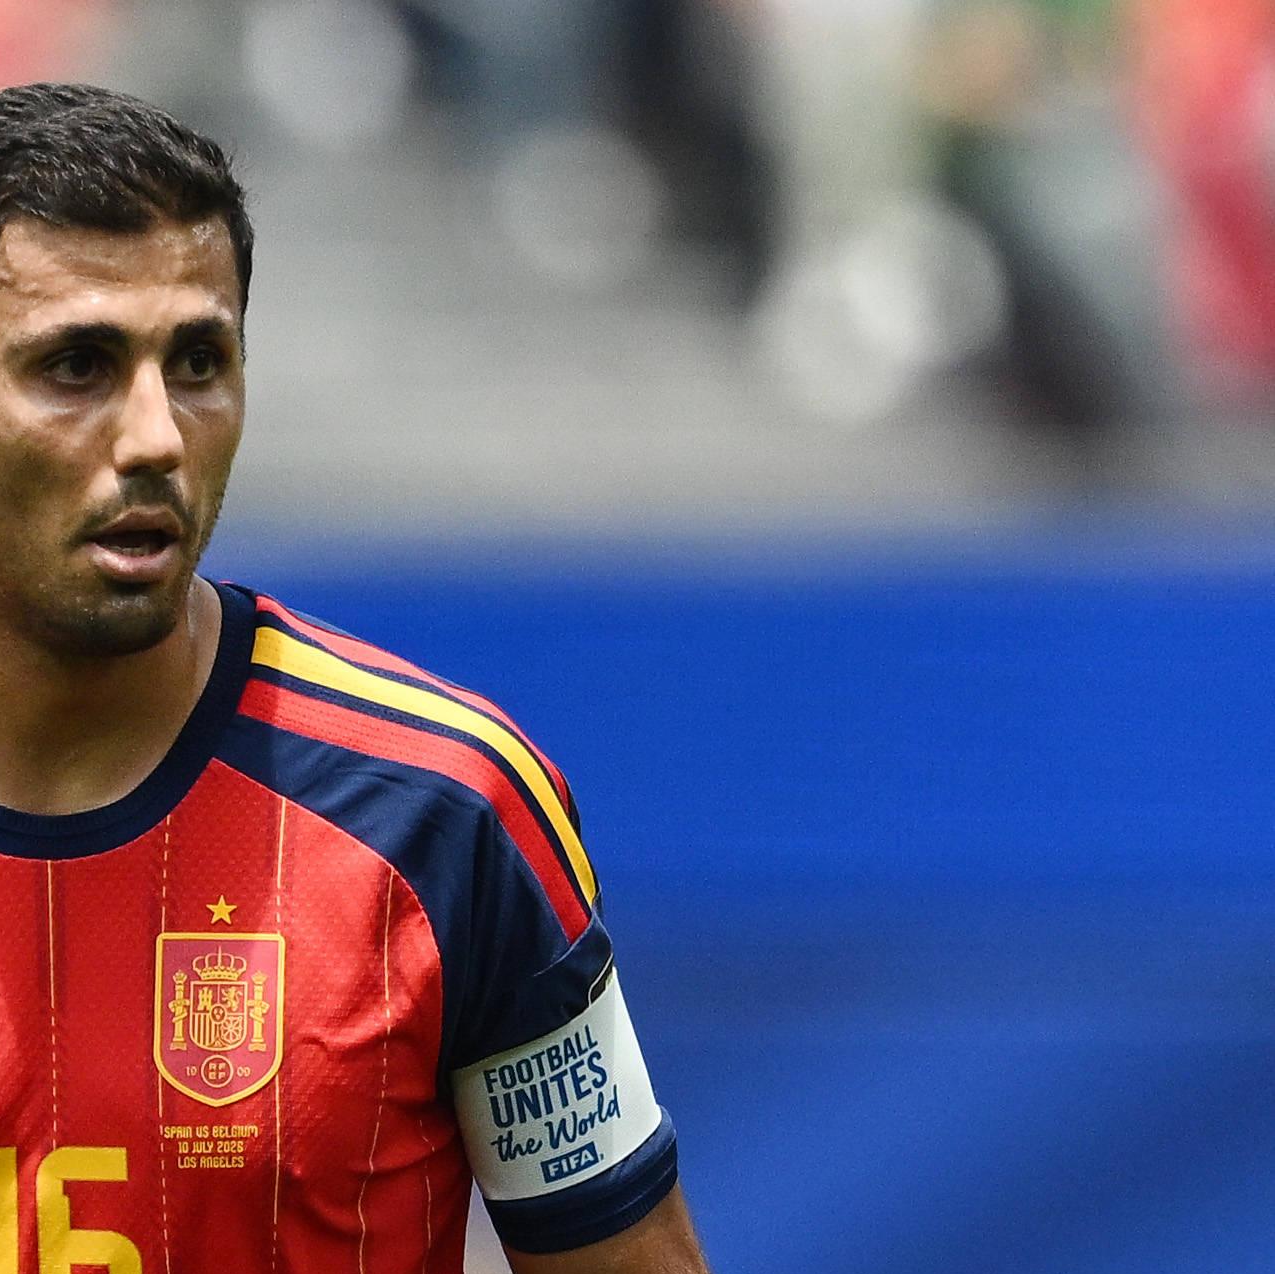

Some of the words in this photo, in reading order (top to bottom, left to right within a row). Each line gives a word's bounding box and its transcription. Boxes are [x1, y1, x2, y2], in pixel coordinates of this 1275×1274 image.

[484, 1024, 598, 1093] FOOTBALL
[489, 1050, 608, 1129] UNITES
[164, 1125, 192, 1138] SPAIN
[212, 1124, 259, 1138] BELGIUM
[491, 1131, 543, 1162] the
[544, 1084, 621, 1150] World
[177, 1156, 197, 1169] LOS
[199, 1155, 244, 1168] ANGELES
[178, 1141, 189, 1154] 10
[191, 1141, 214, 1154] JULY
[216, 1140, 244, 1153] 2026
[546, 1147, 597, 1179] FIFA
